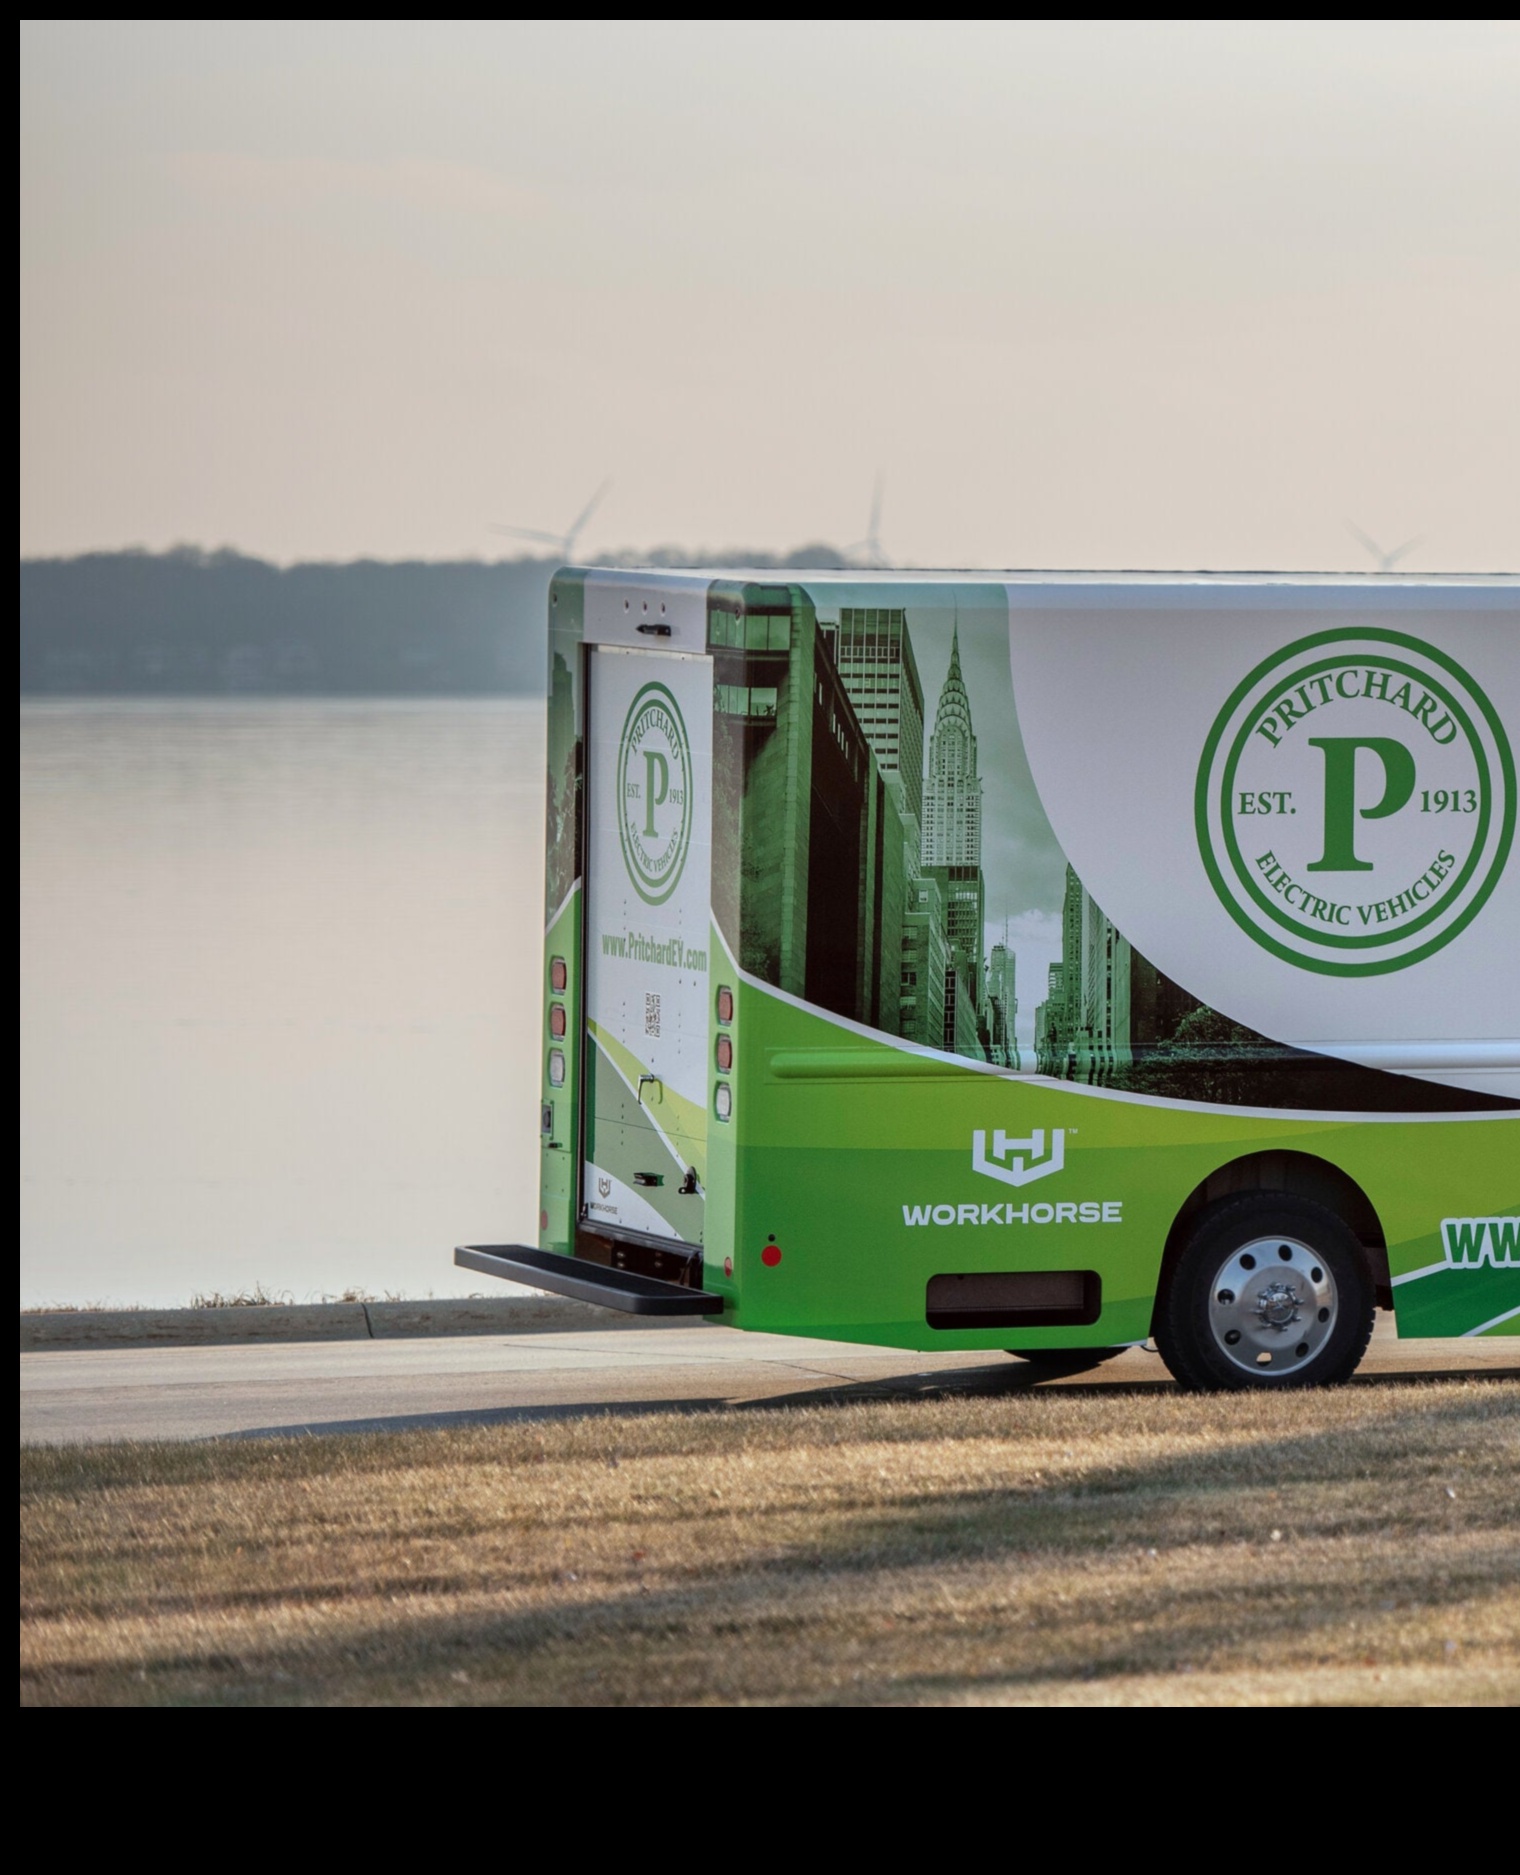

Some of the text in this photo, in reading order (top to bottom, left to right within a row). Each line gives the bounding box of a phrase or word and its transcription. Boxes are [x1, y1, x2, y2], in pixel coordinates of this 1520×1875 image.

[631, 708, 681, 761] PRITCHARD
[1254, 669, 1458, 749] PRITCHARD
[642, 750, 670, 839] P
[1237, 791, 1297, 816] EST.
[1306, 736, 1417, 872] P
[1419, 789, 1478, 814] 1913
[1254, 848, 1456, 927] ELECTRIC VEHICLES
[602, 931, 707, 973] www.PritchardEV.com
[902, 1201, 1123, 1227] WORKHORSE
